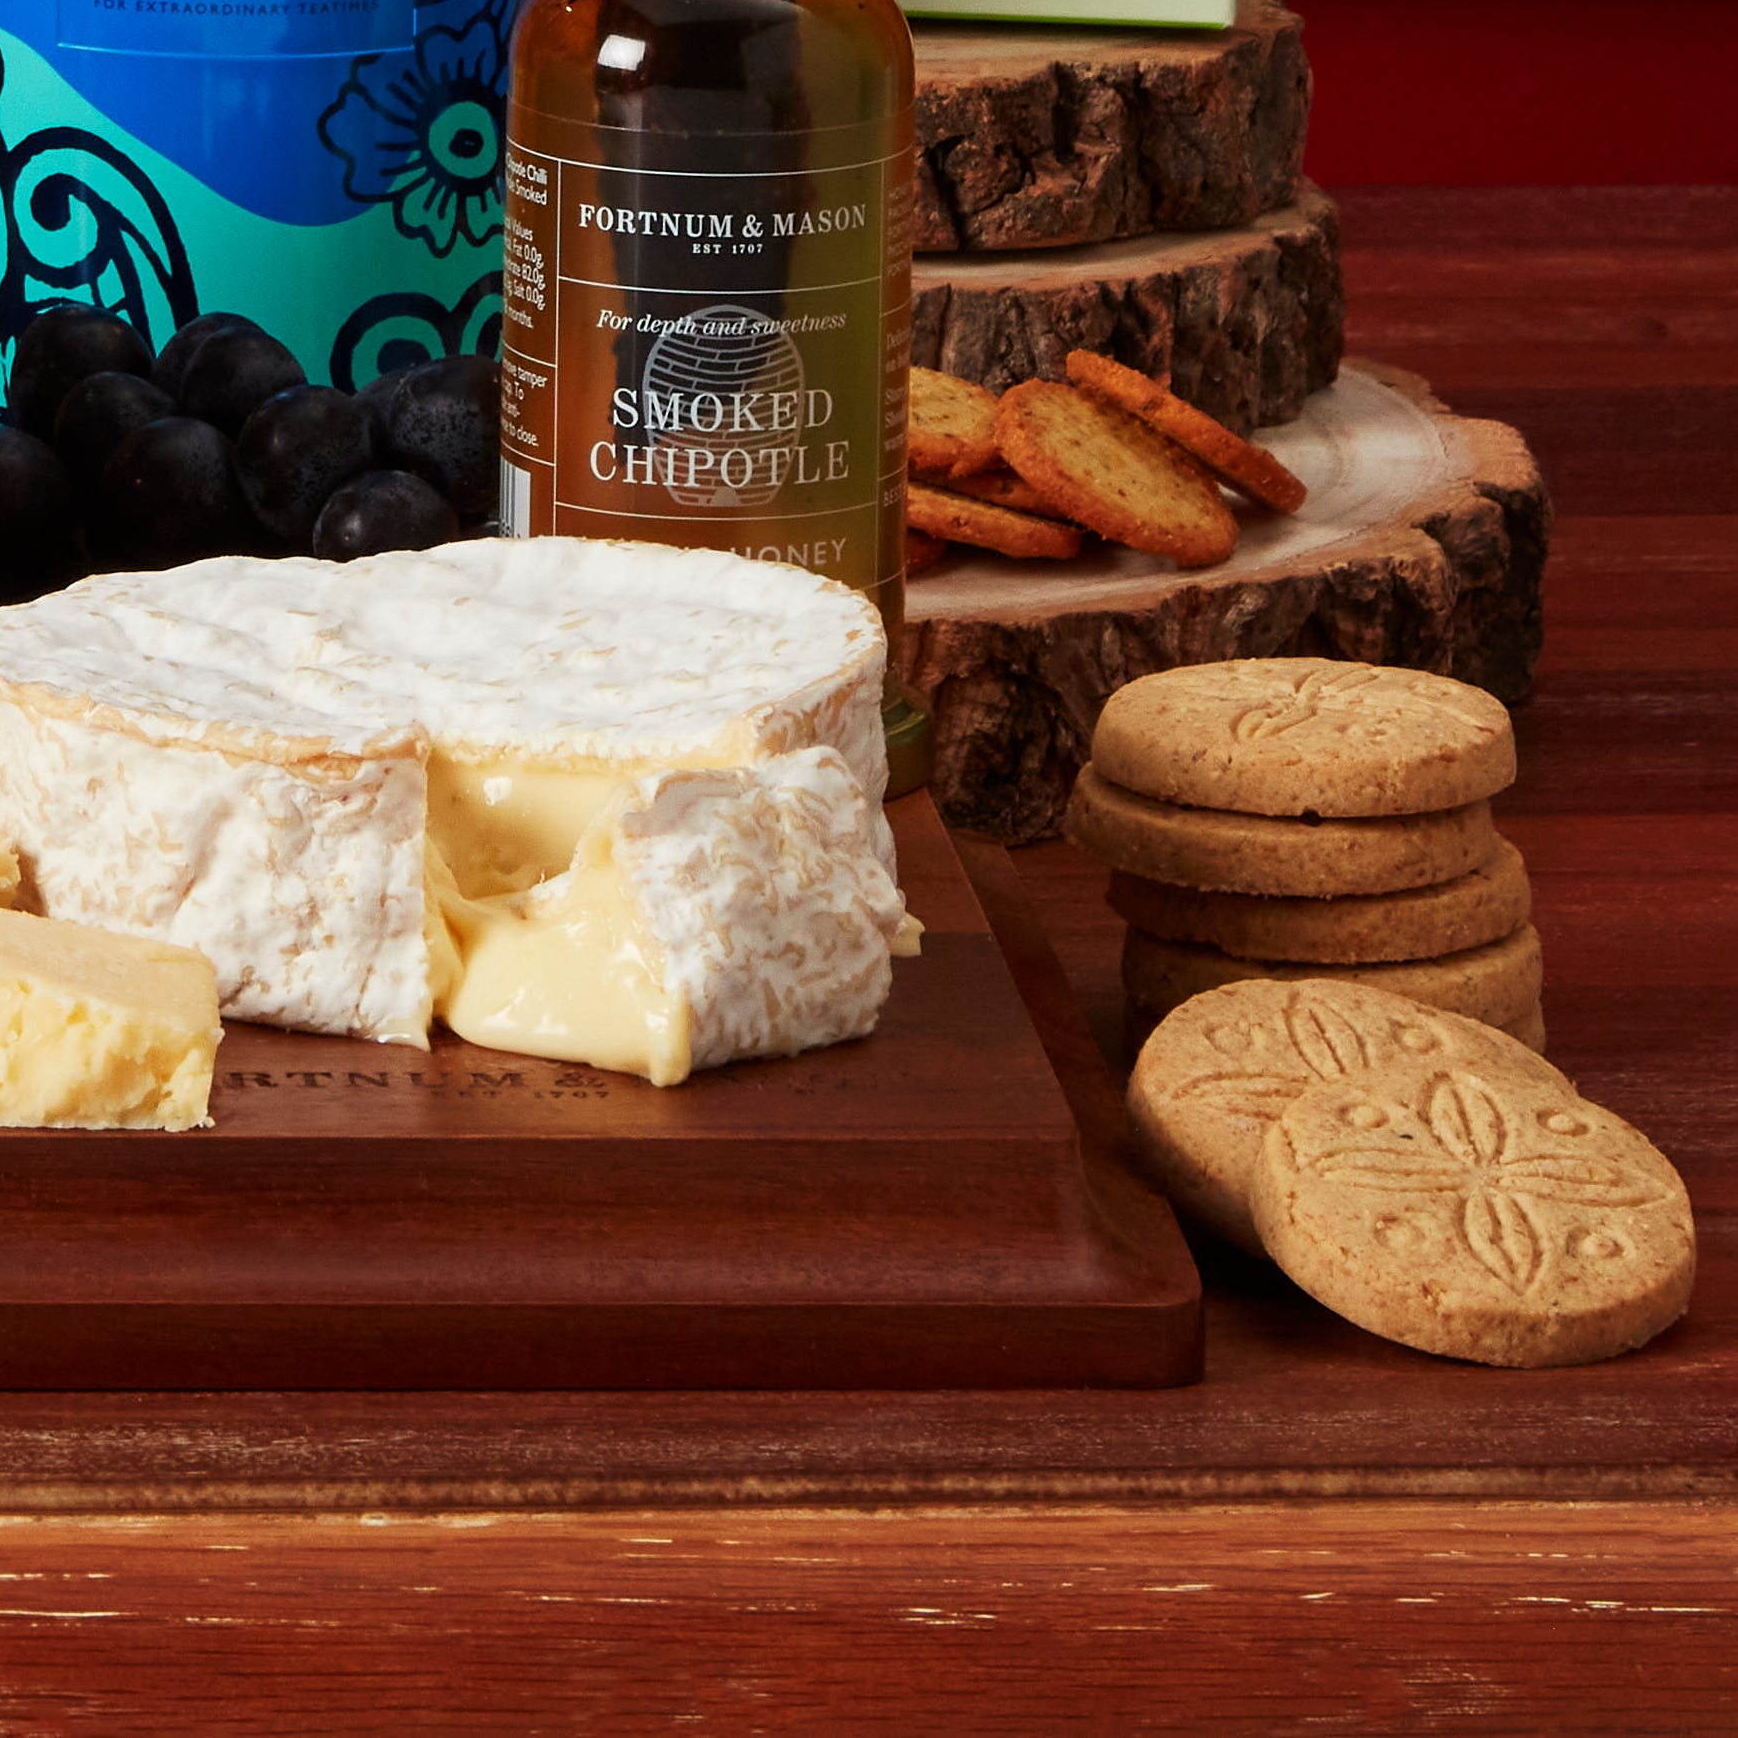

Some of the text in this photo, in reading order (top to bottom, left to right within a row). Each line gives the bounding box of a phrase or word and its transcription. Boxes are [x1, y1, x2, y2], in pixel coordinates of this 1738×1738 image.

[299, 0, 378, 14] TEATIMES
[579, 204, 866, 238] FORTNUM & MASON
[597, 309, 846, 336] For depth and sweetness
[613, 388, 832, 432] SMOKED
[590, 441, 849, 488] CHIPOTLE
